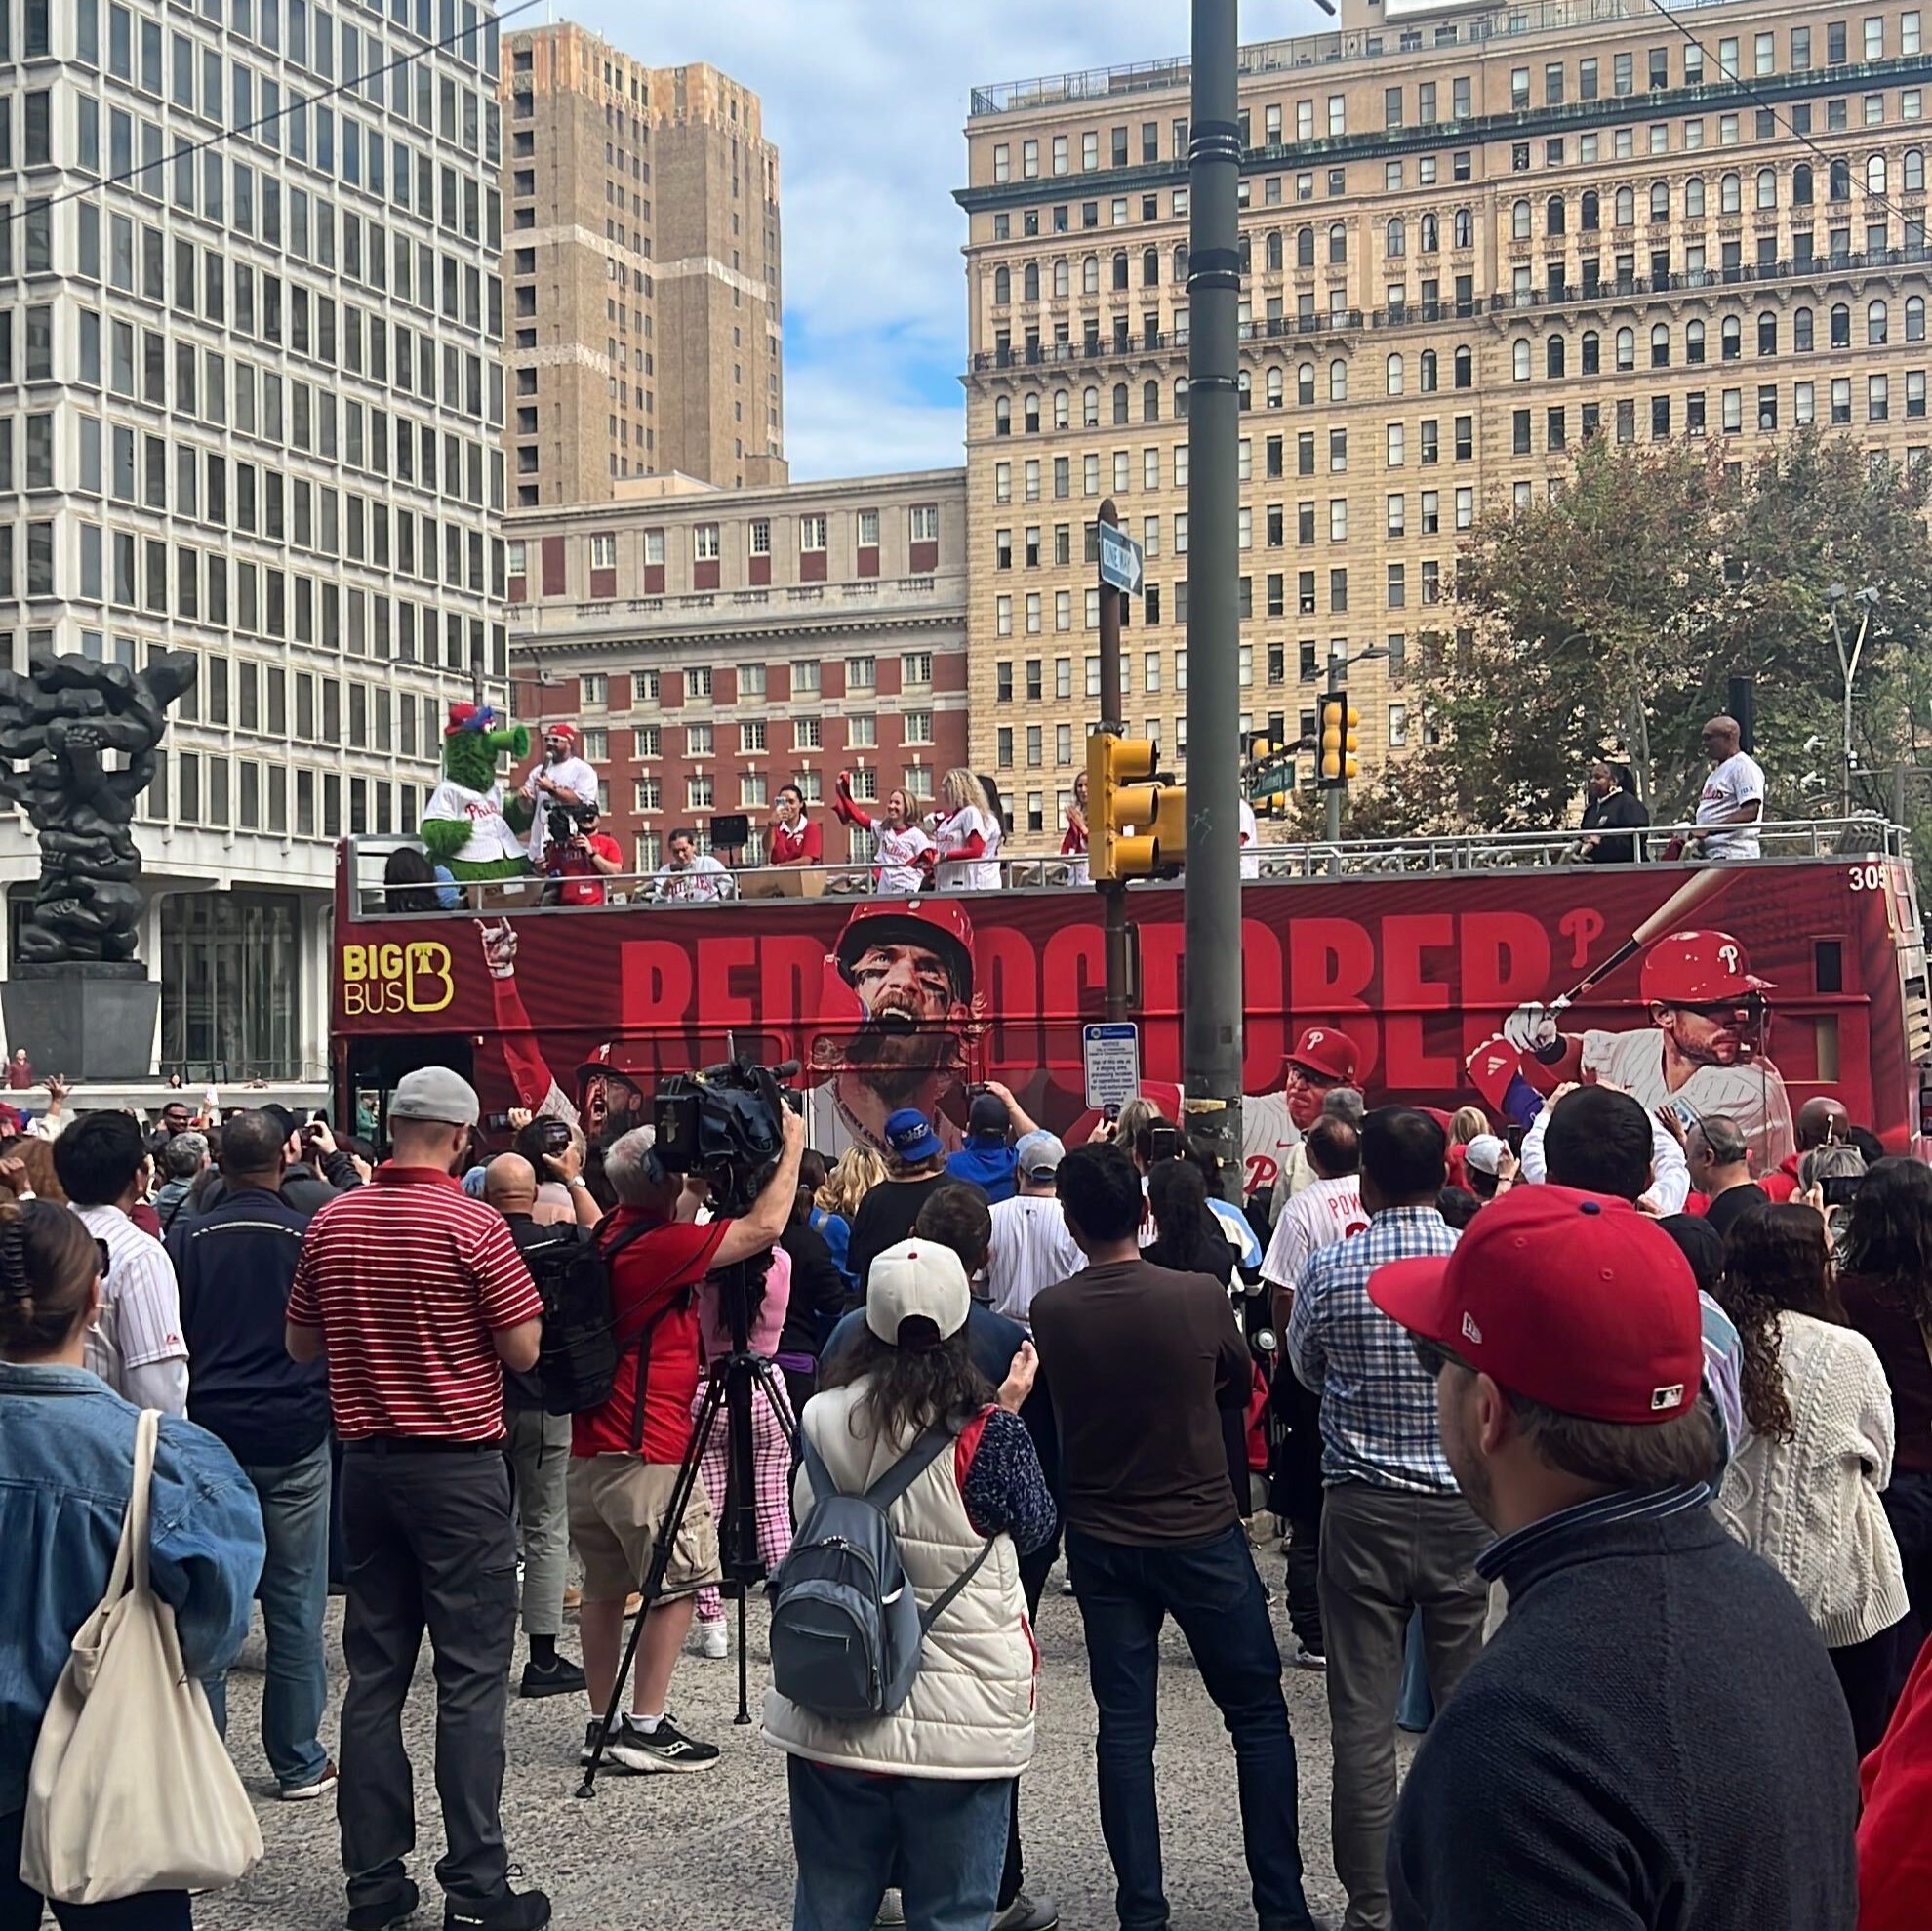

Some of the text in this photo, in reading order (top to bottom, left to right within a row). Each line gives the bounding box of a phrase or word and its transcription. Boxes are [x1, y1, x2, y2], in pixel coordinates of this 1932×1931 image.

[1105, 542, 1132, 576] ONE WAY
[343, 944, 404, 981] BIG
[344, 982, 405, 1015] BUS
